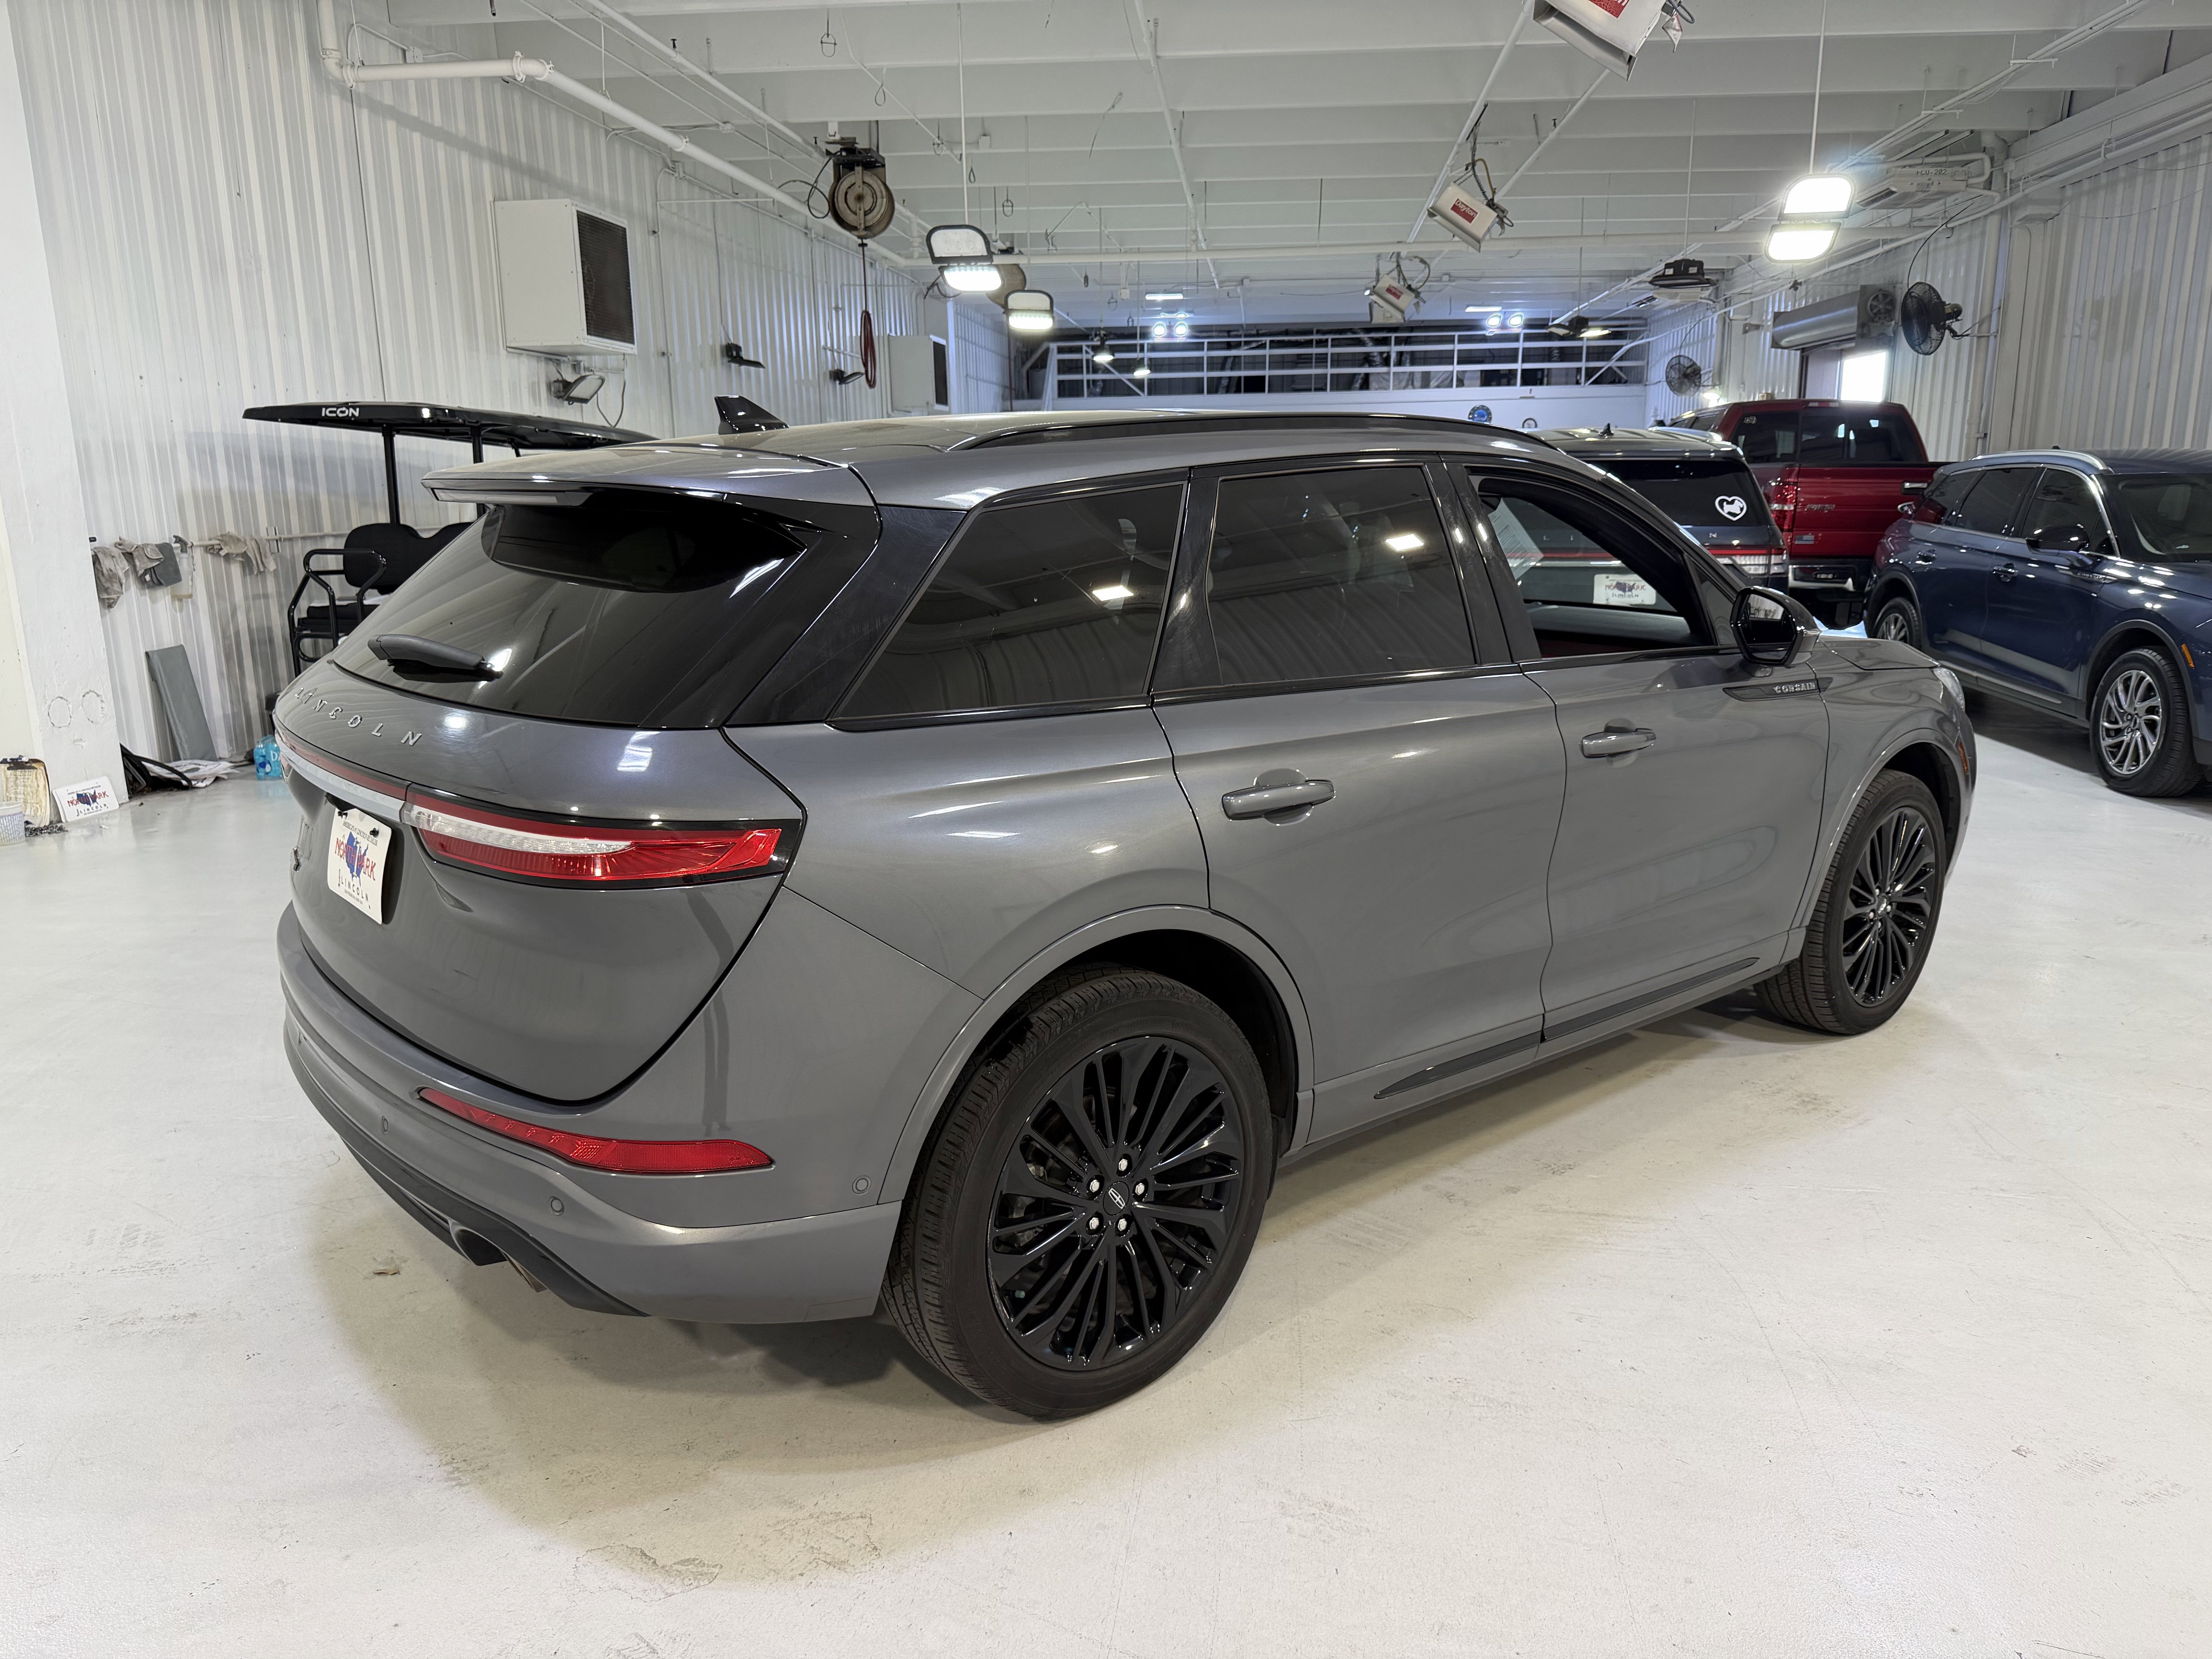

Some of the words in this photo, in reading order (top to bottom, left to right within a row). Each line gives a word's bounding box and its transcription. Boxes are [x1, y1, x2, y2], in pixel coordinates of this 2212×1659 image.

[321, 407, 359, 417] ICON
[1774, 682, 1815, 694] CORSAIR
[295, 687, 422, 746] LINCOLN
[357, 851, 377, 881] PARK
[341, 875, 369, 902] LINCOLN
